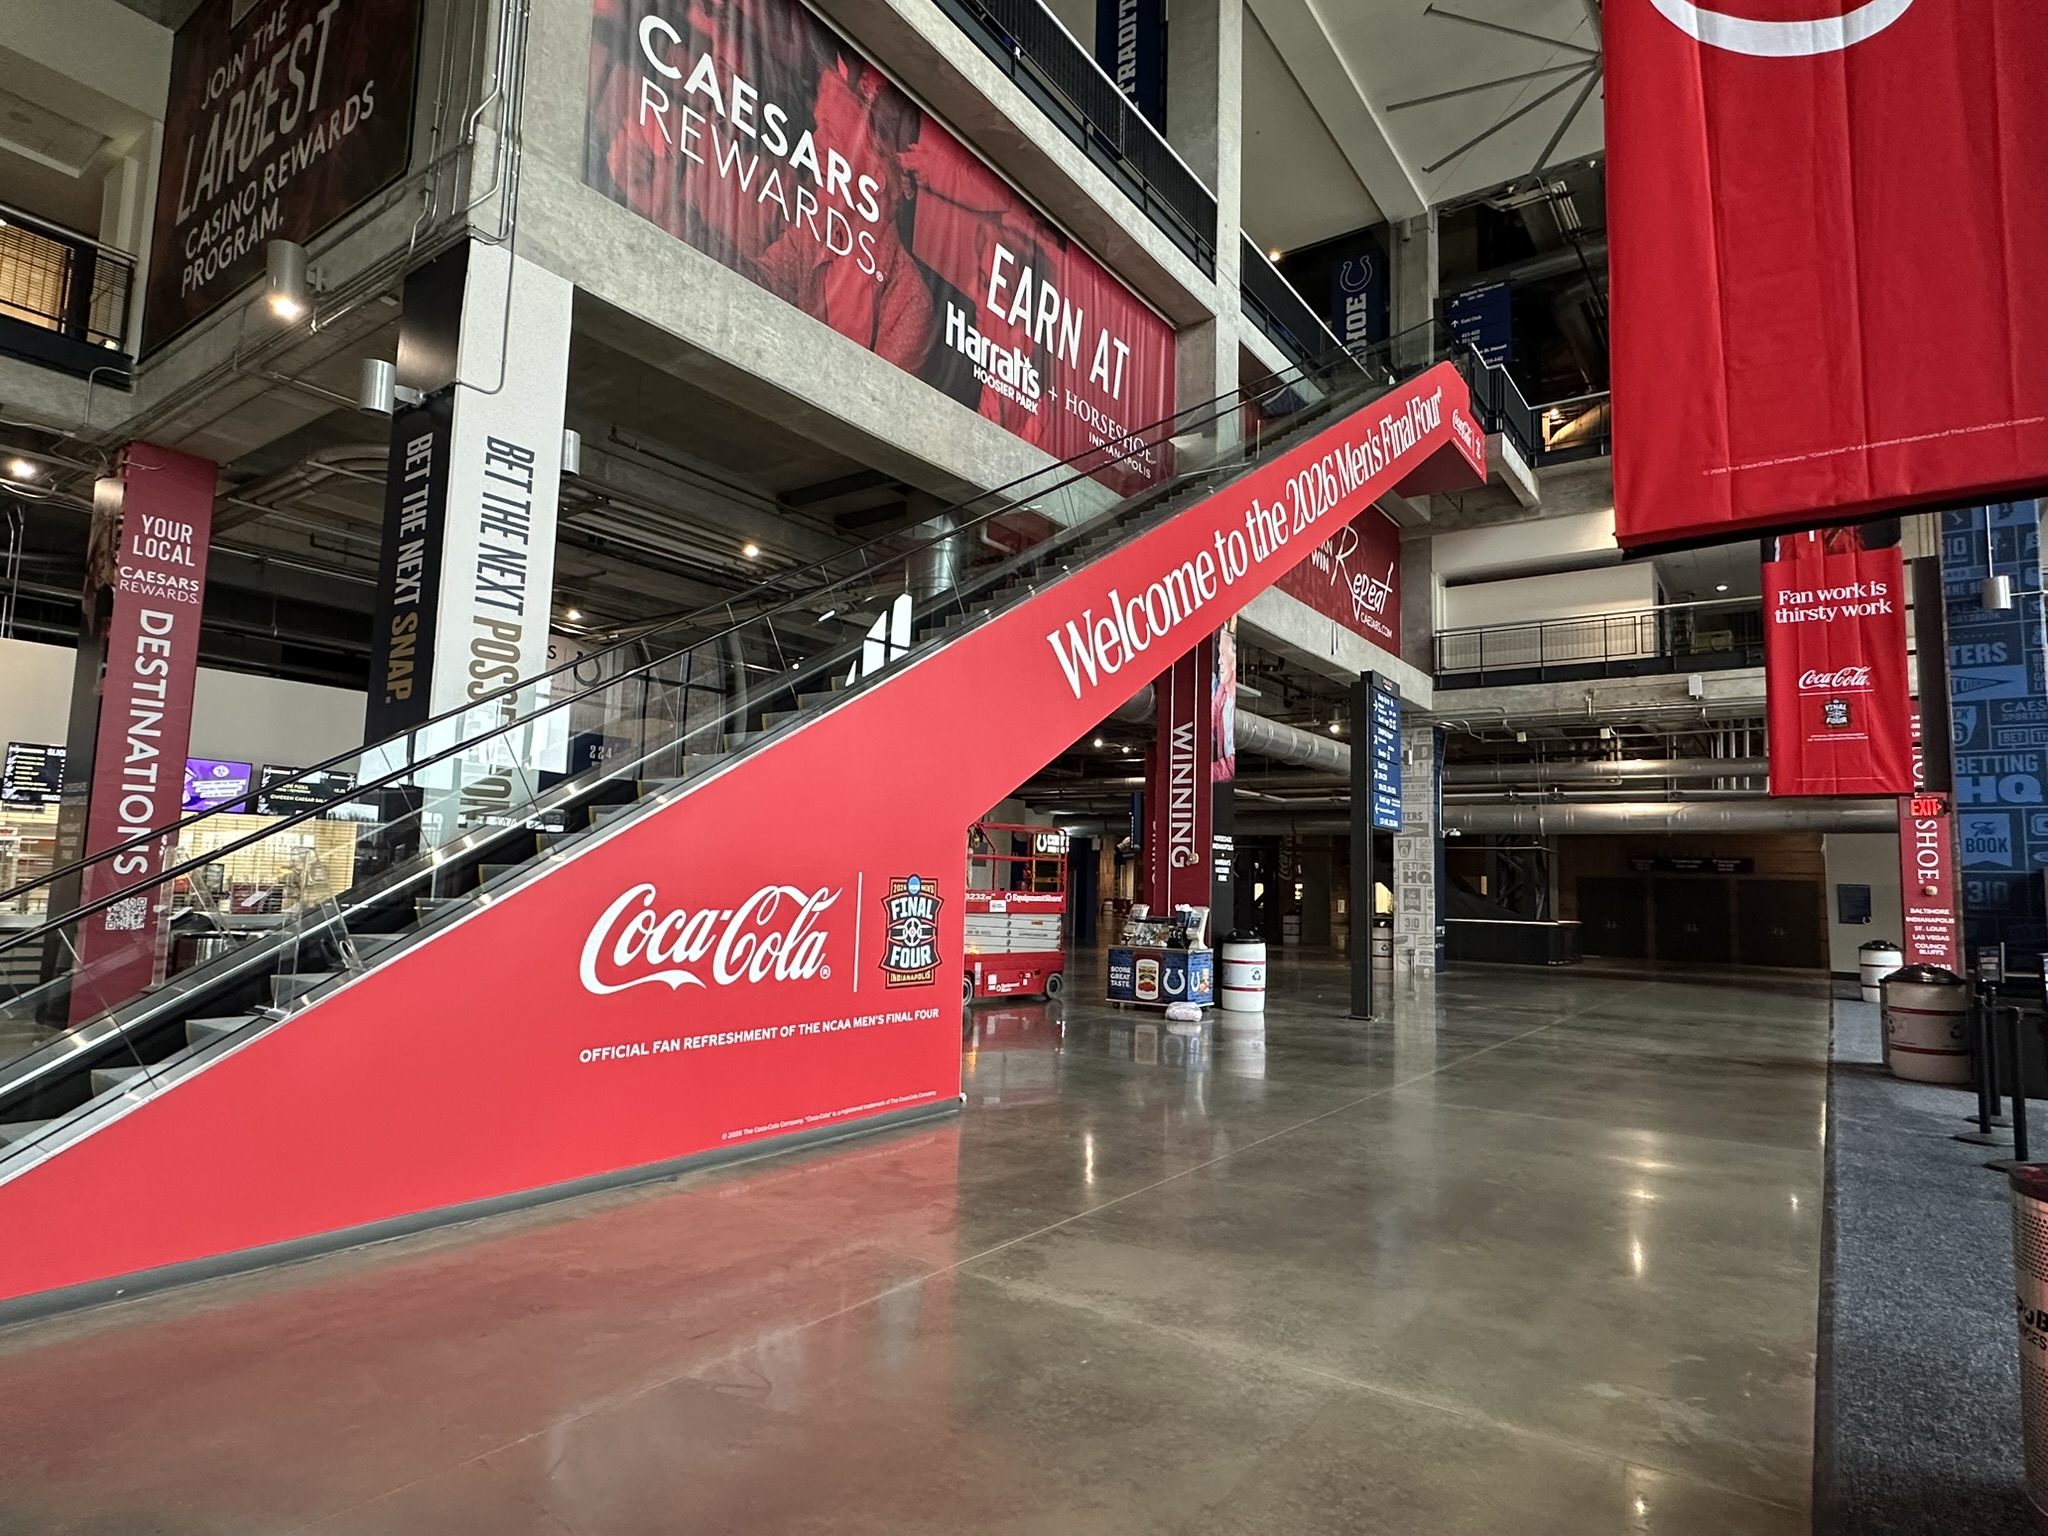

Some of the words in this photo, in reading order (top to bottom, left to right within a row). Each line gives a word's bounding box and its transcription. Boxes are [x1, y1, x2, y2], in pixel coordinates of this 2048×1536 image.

[201, 45, 246, 110] JOIN
[253, 2, 288, 61] THE
[176, 0, 340, 226] LARGEST
[639, 15, 880, 222] CAESARS
[185, 180, 257, 259] CASINO
[263, 80, 374, 199] REWARDS
[181, 197, 284, 298] PROGRAM.
[986, 243, 1083, 369] EARN
[1089, 328, 1130, 400] AT
[973, 366, 1015, 404] HOOSIER
[1015, 391, 1038, 415] PARK
[404, 431, 434, 481] BET
[485, 436, 535, 494] BET
[399, 484, 430, 538] THE
[480, 491, 531, 546] THE
[142, 514, 193, 545] YOUR
[132, 535, 195, 567] LOCAL
[1047, 548, 1217, 699] Welcome
[1214, 529, 1248, 586] to
[1245, 499, 1289, 564] the
[1286, 453, 1338, 536] 2026
[1334, 428, 1380, 499] Men's
[1379, 398, 1418, 467] Final
[119, 566, 199, 592] CAESARS
[393, 544, 425, 605] NEXT
[474, 551, 527, 616] NEXT
[1330, 523, 1393, 621] Repeat
[1778, 589, 1813, 606] Fan
[1817, 582, 1867, 601] work
[1870, 580, 1887, 596] is
[1774, 604, 1837, 624] thirsty
[1838, 599, 1892, 617] work
[385, 610, 419, 704] SNAP.
[1799, 666, 1872, 689] Coca-Cola
[112, 608, 174, 875] DESTINATIONS
[588, 745, 613, 760] 224
[1955, 754, 2039, 776] BETTING
[1171, 721, 1194, 868] WINNING
[1956, 774, 2044, 804] HQ
[1911, 798, 1938, 816] EXIT
[1965, 837, 2009, 854] BOOK
[1402, 862, 1432, 871] BETTING
[1403, 871, 1432, 884] HQ
[891, 896, 933, 920] FINAL
[1905, 916, 1955, 924] INDIANAPOLIS
[1910, 907, 1950, 915] BALTIMORE
[579, 883, 843, 994] Coca-Cola
[1918, 949, 1945, 957] BLUFFS
[1926, 934, 1950, 942] VEGAS
[889, 944, 932, 969] FOUR
[1110, 965, 1131, 974] SCORE
[890, 970, 931, 982] INDIANAPOLIS
[1110, 973, 1131, 982] GREAT
[1110, 980, 1130, 988] TASTE
[579, 1041, 650, 1063] OFFICIAL
[652, 1037, 681, 1054] FAN
[683, 1026, 777, 1049] REFRESHMENT
[779, 1024, 797, 1039] OF
[798, 1020, 821, 1036] THE
[822, 1018, 851, 1033] NCAA
[853, 1013, 884, 1029] MEN'S
[885, 1010, 913, 1025] FINAL
[914, 1008, 939, 1021] FOUR
